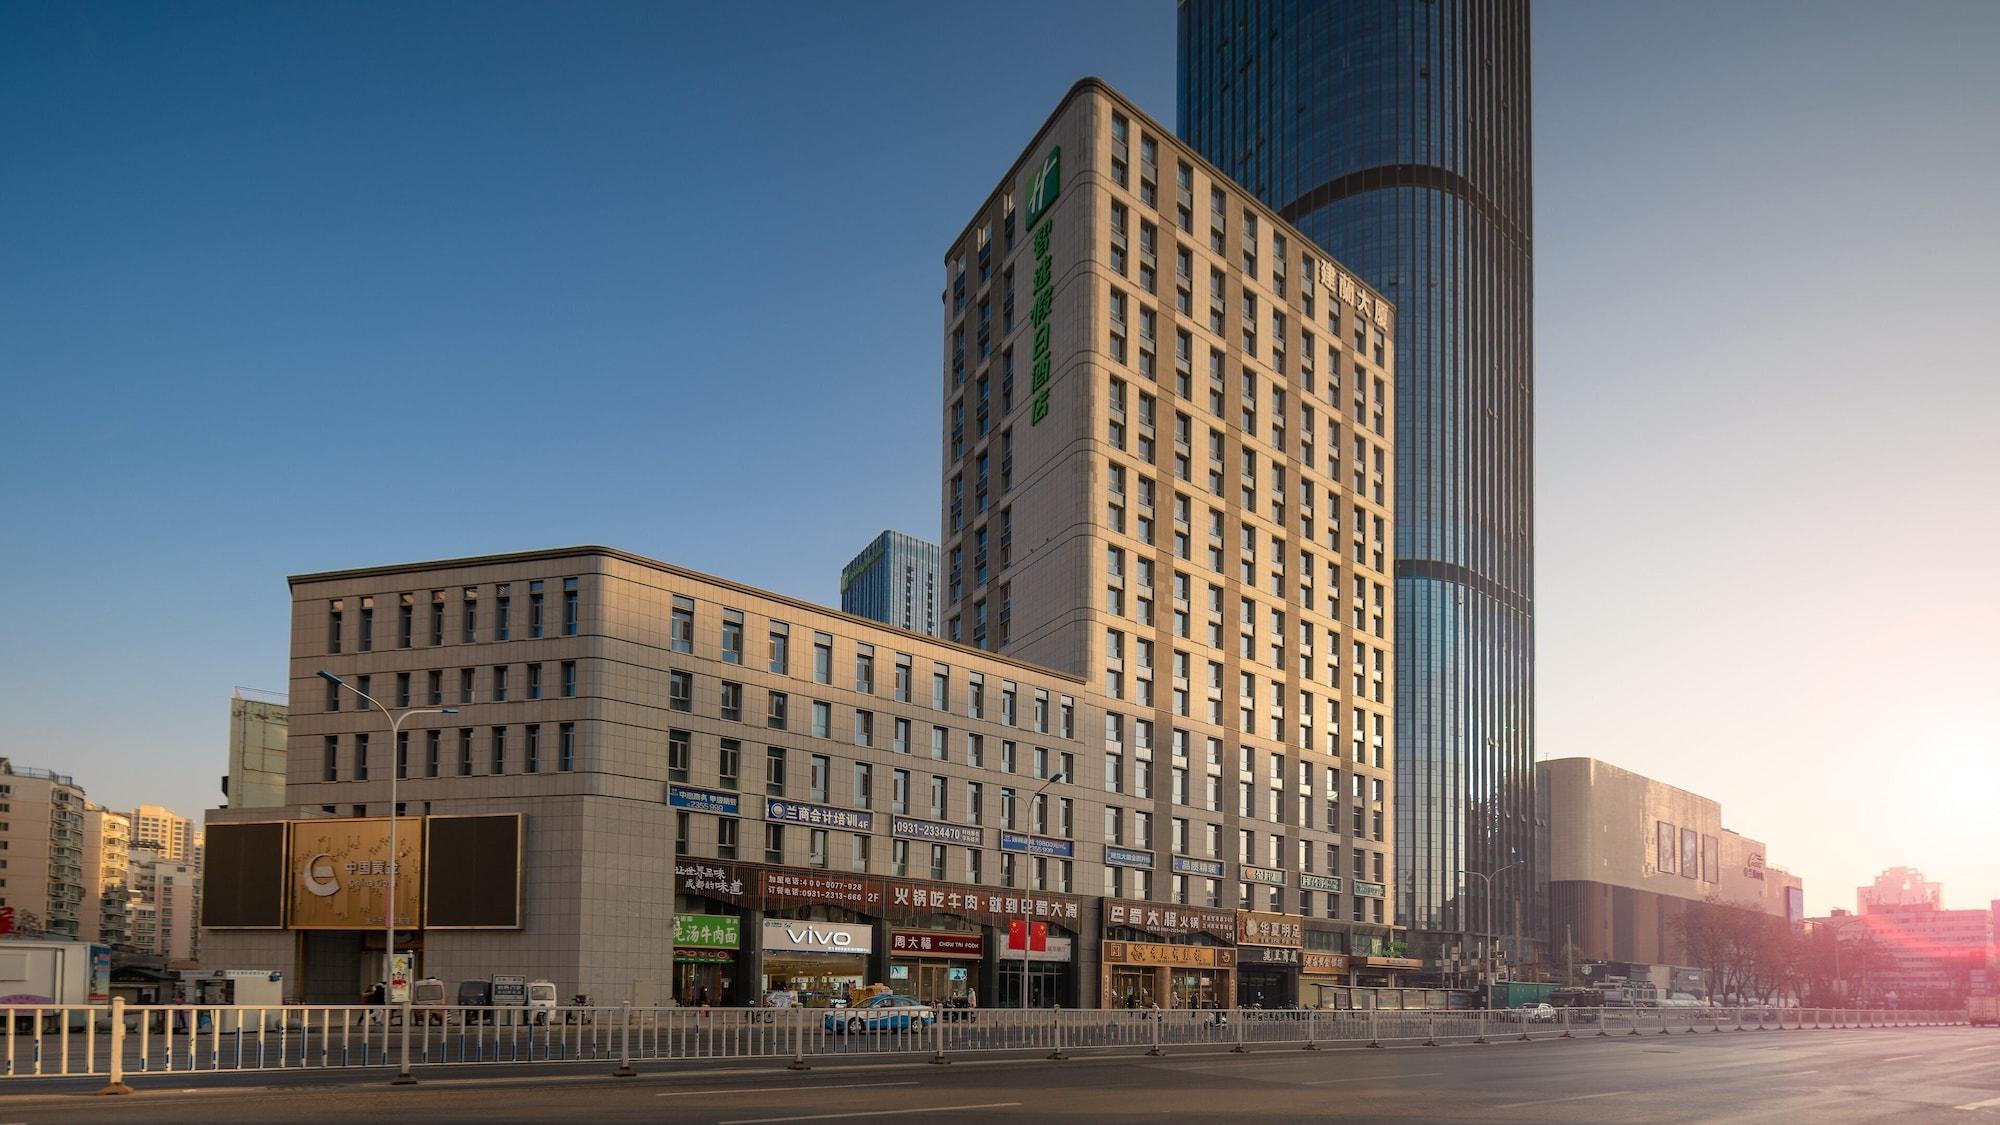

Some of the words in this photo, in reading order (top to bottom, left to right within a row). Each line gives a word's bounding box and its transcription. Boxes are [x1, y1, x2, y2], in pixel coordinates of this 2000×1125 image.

[786, 805, 858, 828] 兰商会计培训
[896, 821, 960, 839] 0931-2334470
[685, 879, 743, 895] 成都的味道
[867, 892, 879, 903] 2F
[787, 924, 851, 946] vivo
[894, 935, 932, 950] 周大福
